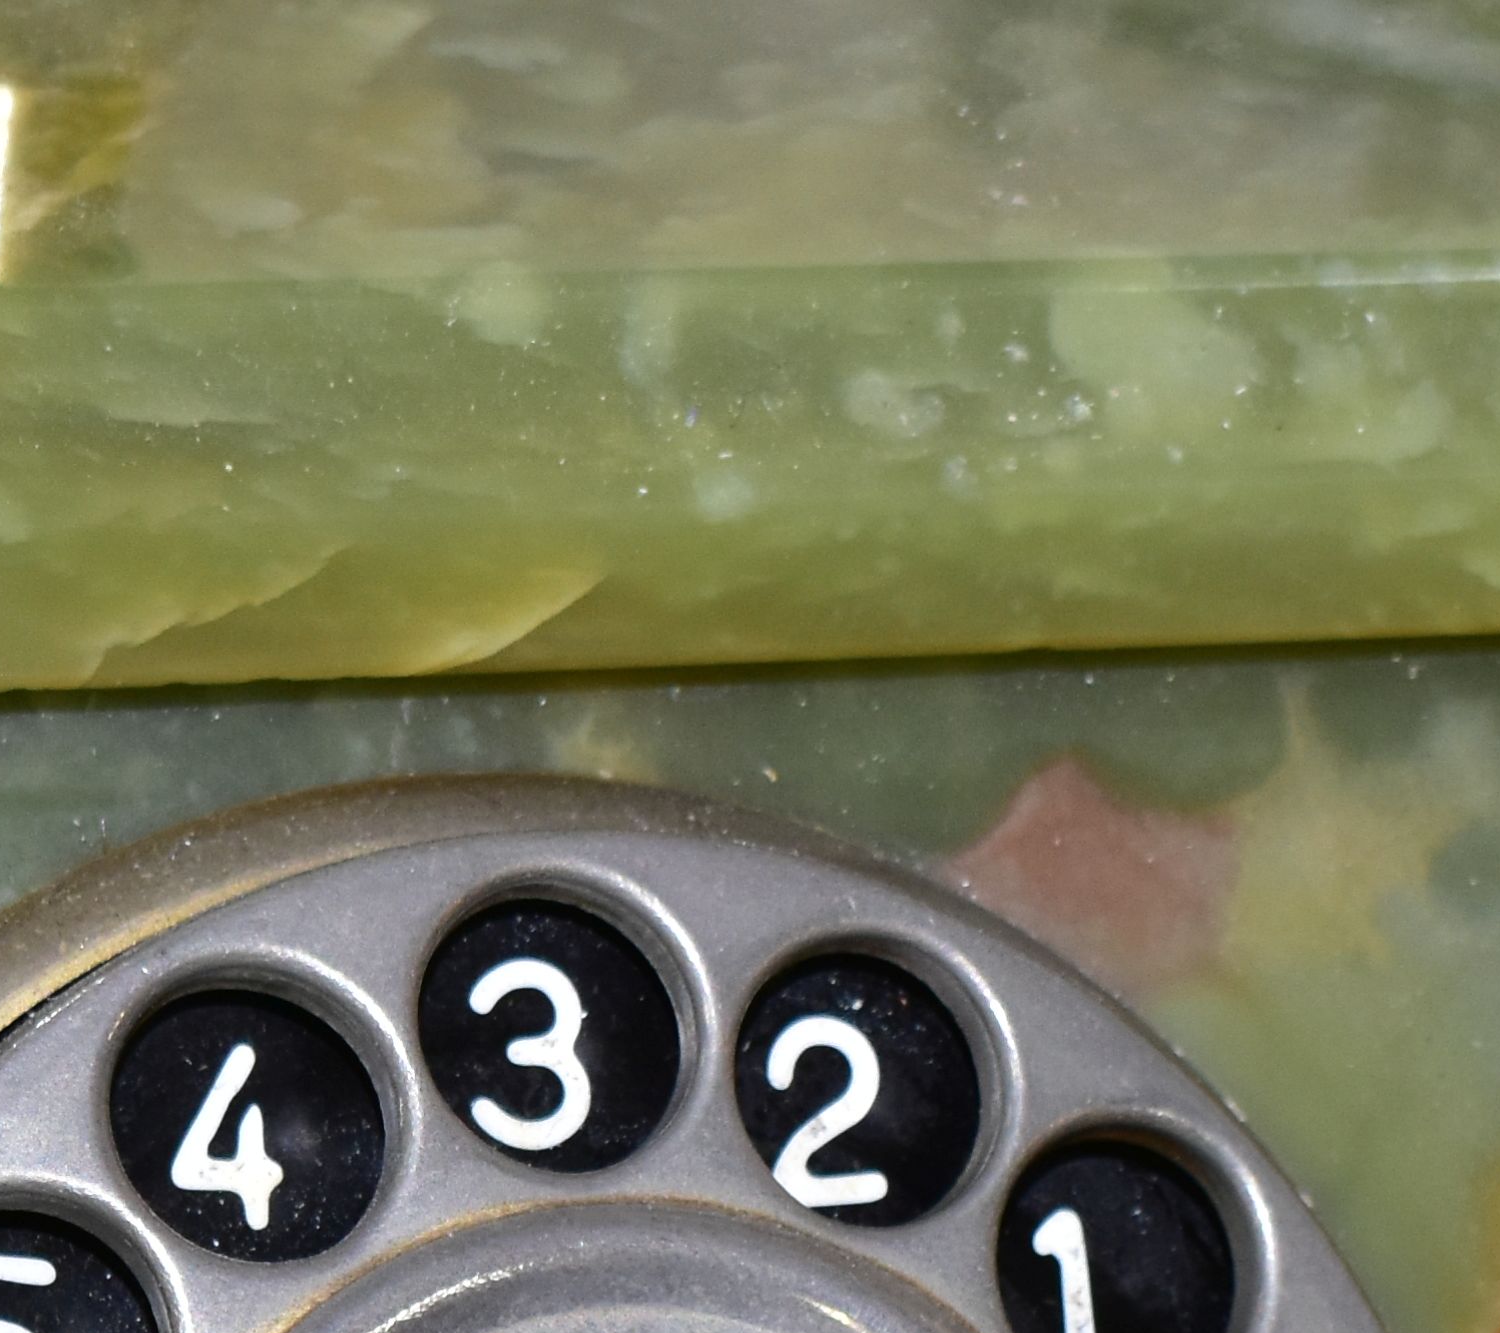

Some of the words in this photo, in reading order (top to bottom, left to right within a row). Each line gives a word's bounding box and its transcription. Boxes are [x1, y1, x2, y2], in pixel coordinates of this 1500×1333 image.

[170, 1042, 284, 1231] 4
[468, 957, 592, 1151] 3
[767, 1014, 889, 1208] 2
